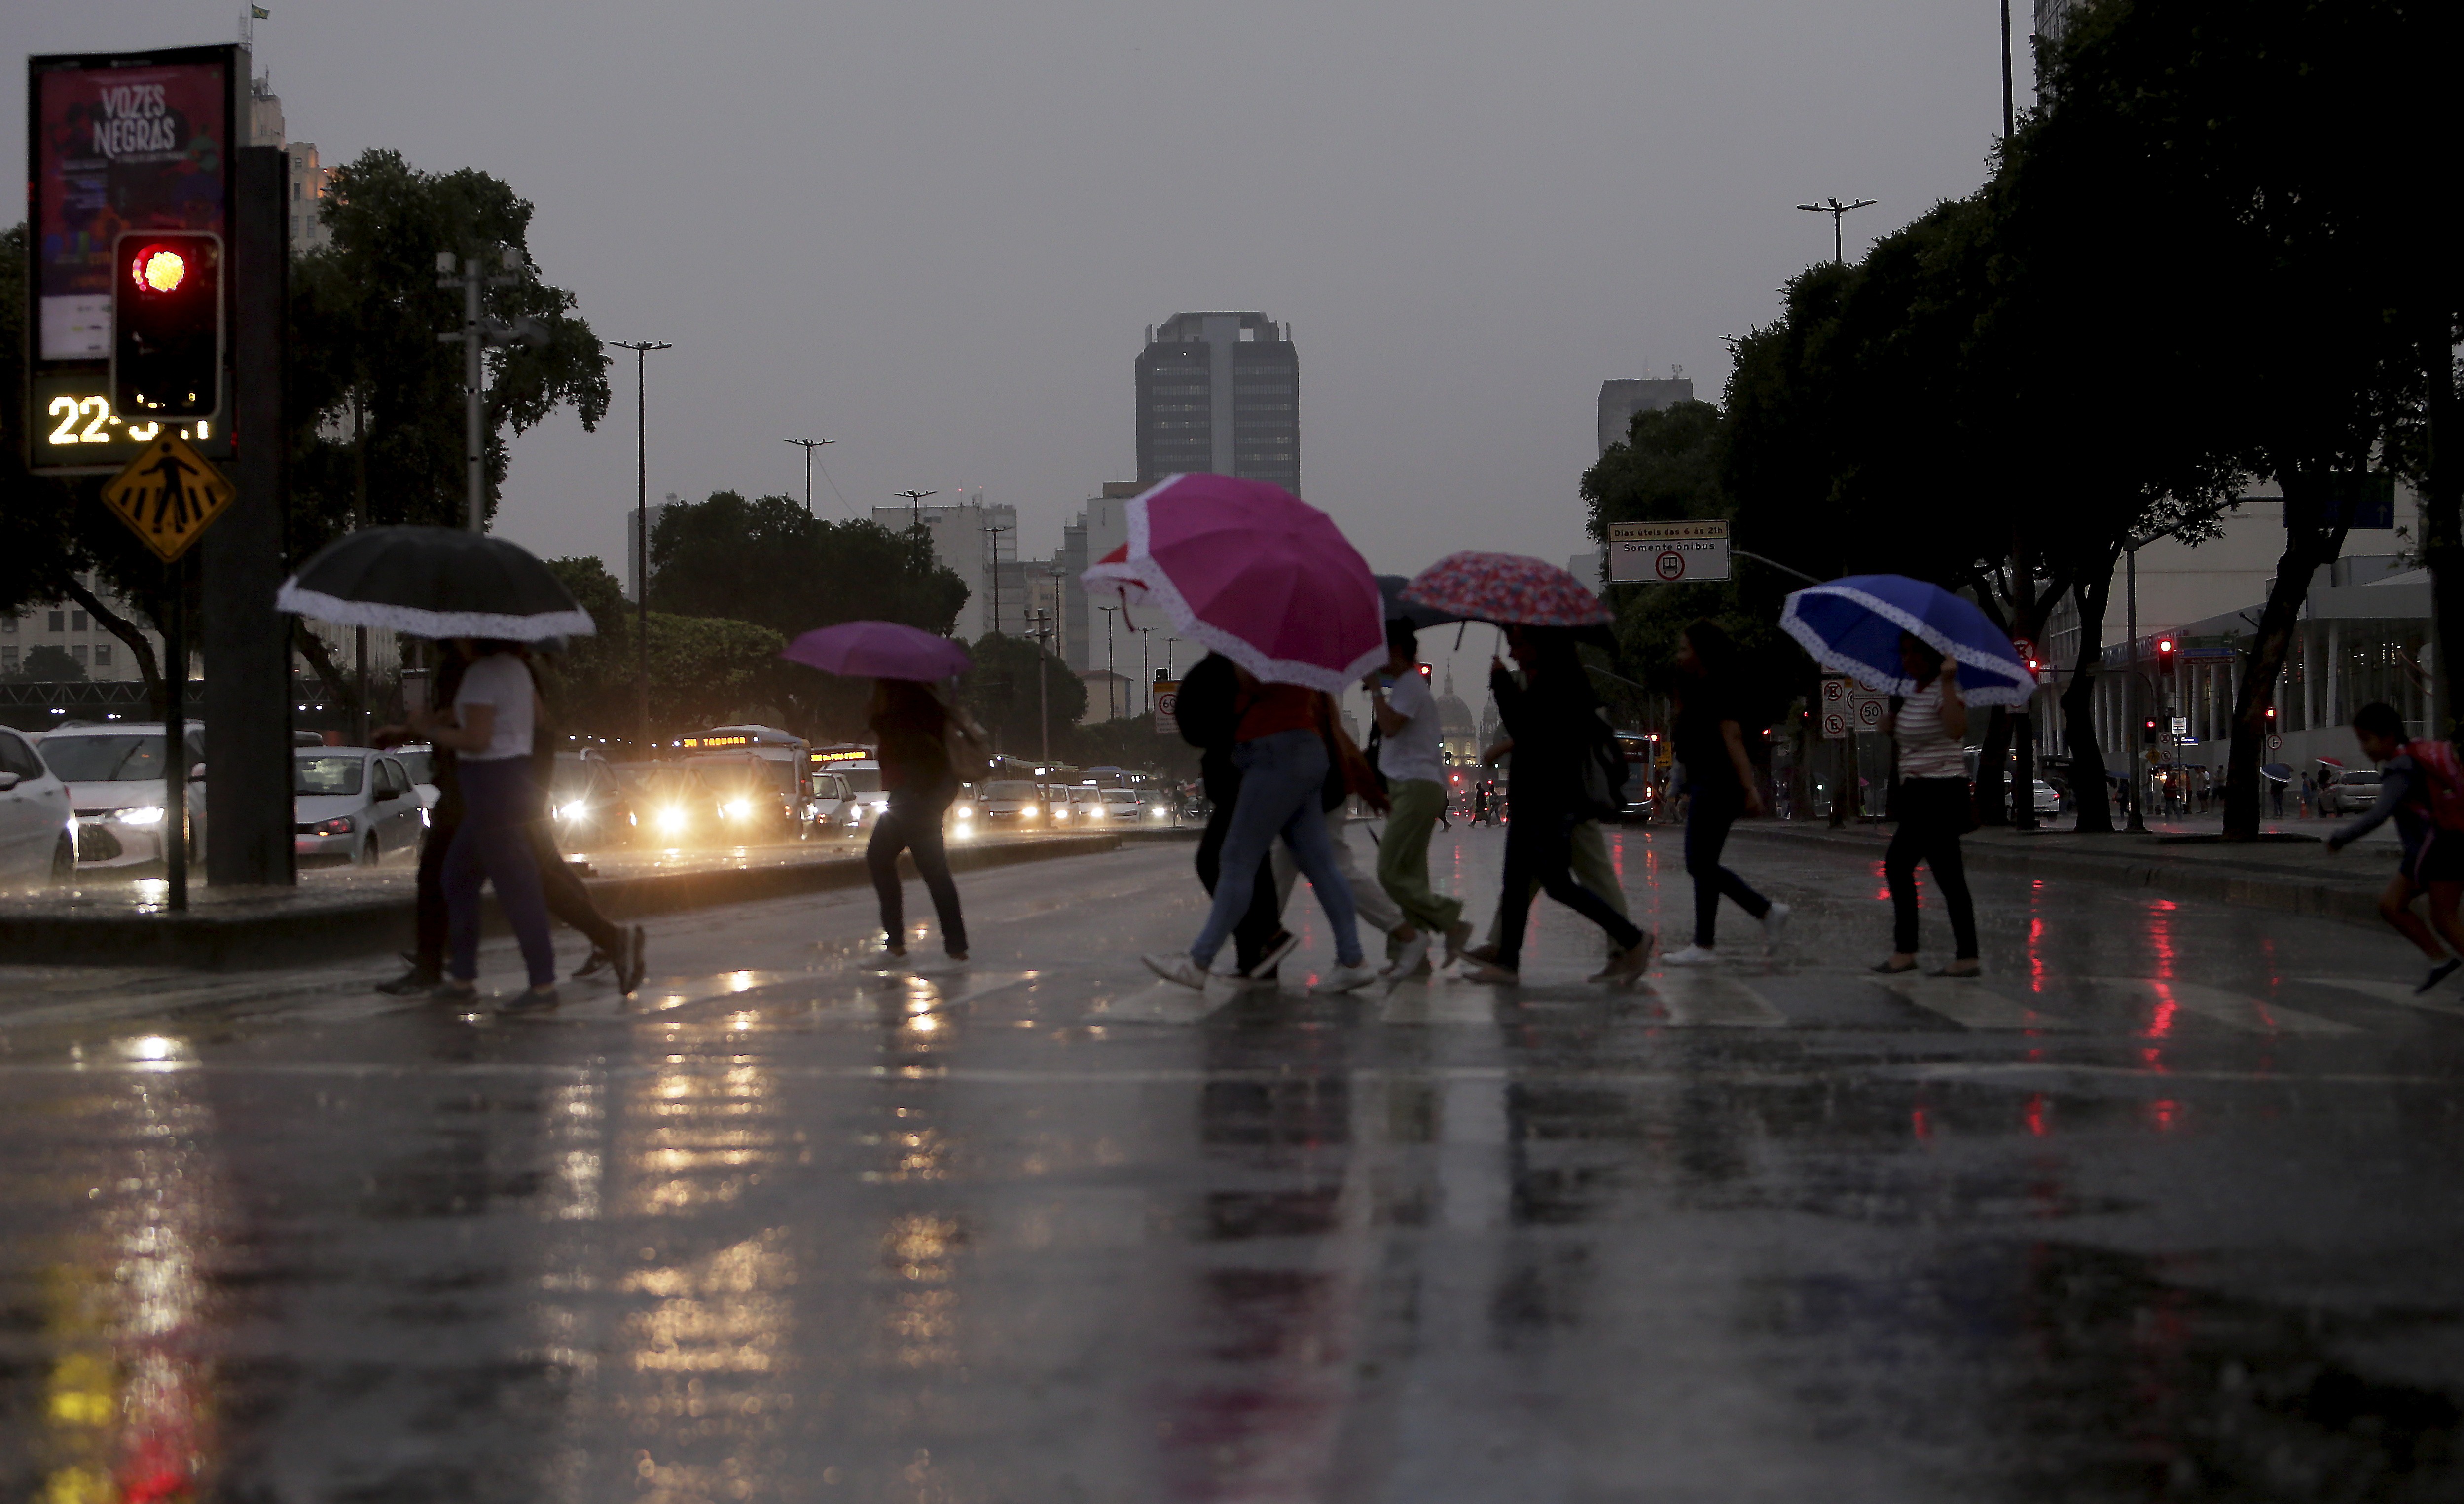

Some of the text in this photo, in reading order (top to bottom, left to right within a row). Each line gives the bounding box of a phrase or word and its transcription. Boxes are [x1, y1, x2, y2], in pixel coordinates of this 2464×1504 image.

[100, 84, 166, 119] VOZES
[92, 116, 176, 158] NEGRAS
[1624, 542, 1715, 551] Somente ônibus
[1163, 698, 1176, 708] 60
[1864, 706, 1879, 717] 50
